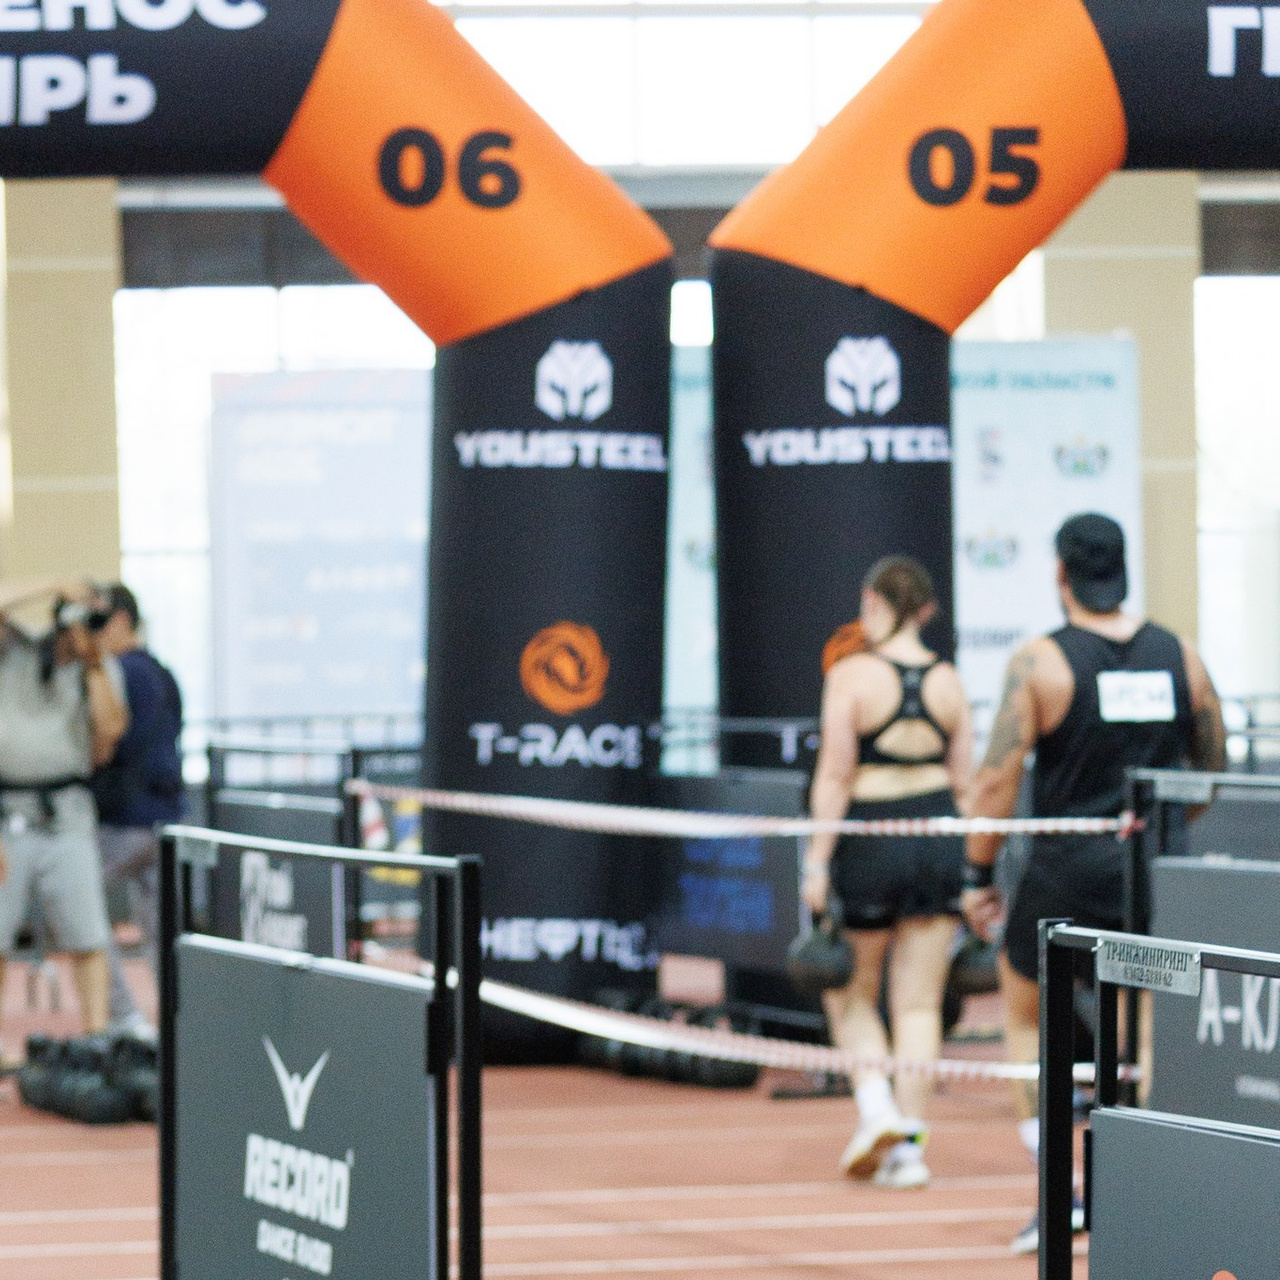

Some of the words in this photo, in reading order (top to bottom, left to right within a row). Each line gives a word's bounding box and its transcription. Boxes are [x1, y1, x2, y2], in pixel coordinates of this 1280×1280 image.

[1206, 5, 1280, 78] Г
[377, 126, 524, 210] 06
[906, 126, 1042, 207] 05
[243, 1133, 351, 1231] RECORD
